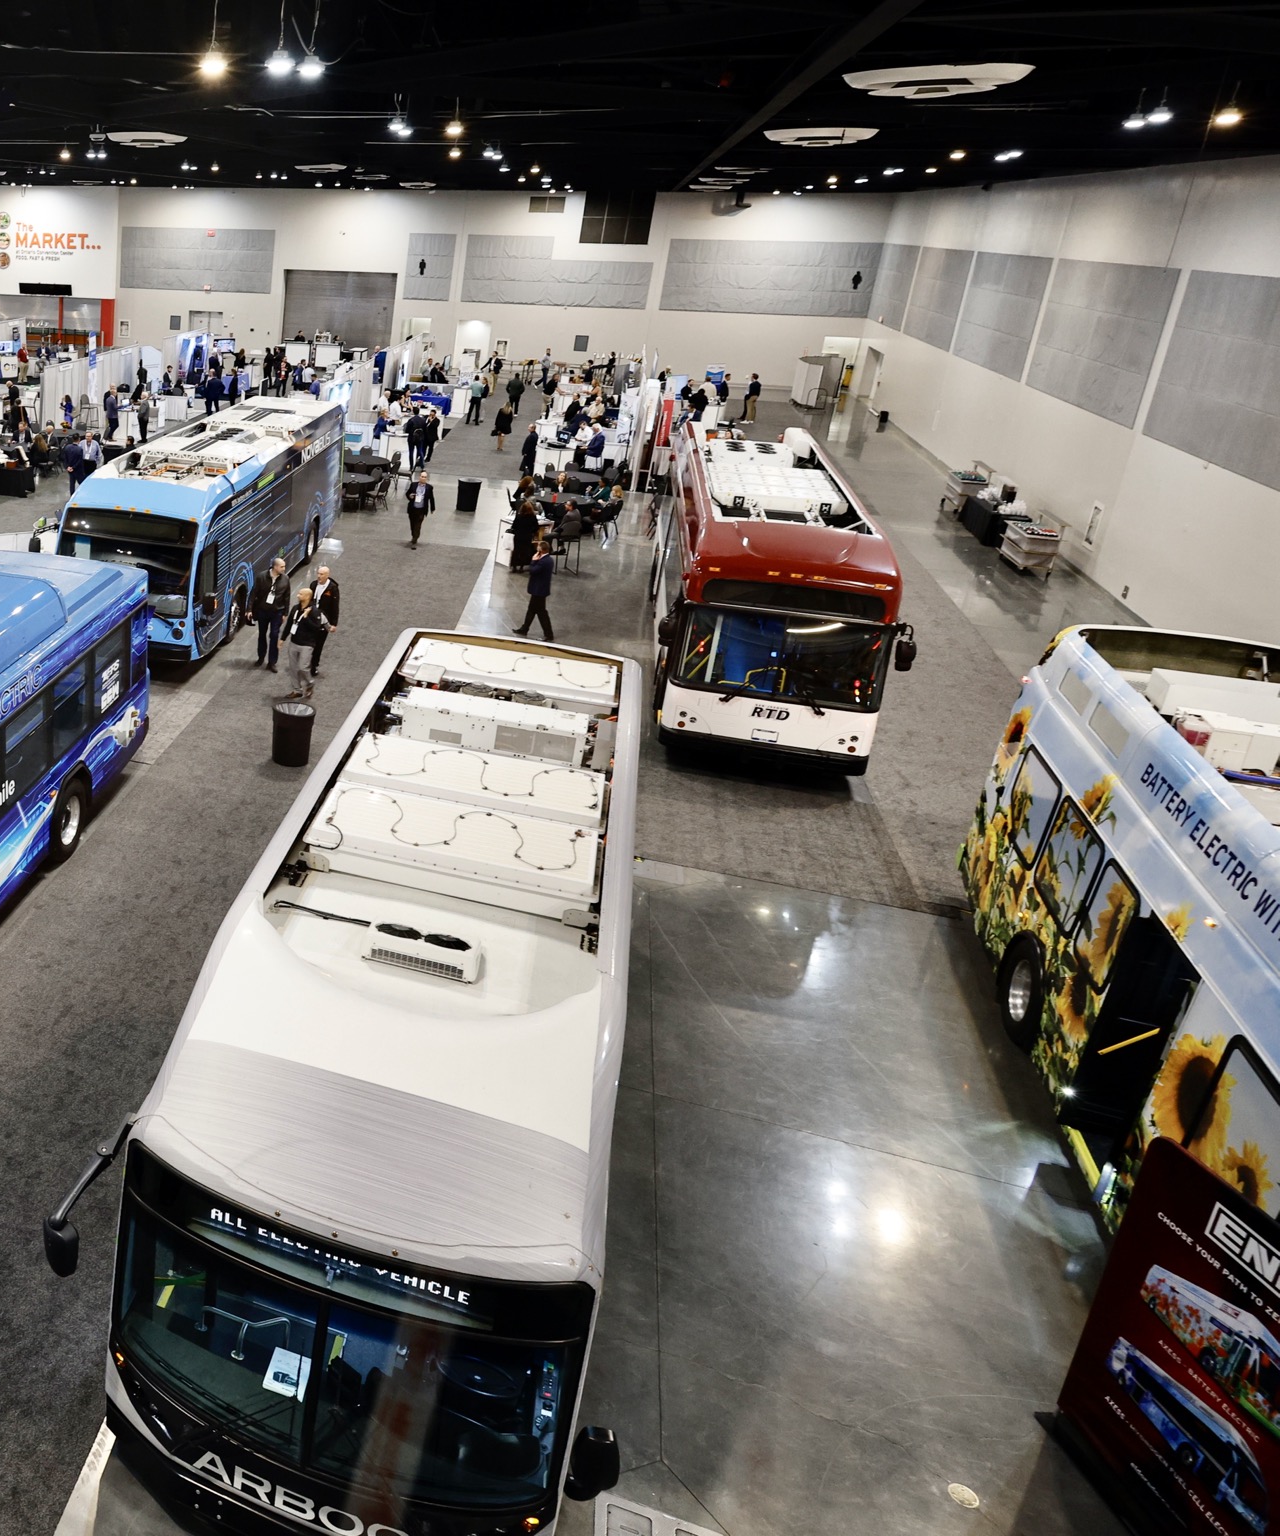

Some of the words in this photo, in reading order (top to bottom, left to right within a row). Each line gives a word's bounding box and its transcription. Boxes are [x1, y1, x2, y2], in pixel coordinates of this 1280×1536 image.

[15, 232, 101, 250] MARKET...
[16, 222, 33, 231] The
[751, 706, 790, 721] RTD
[1140, 762, 1196, 828] BATTERY
[1189, 818, 1258, 900] ELECTRIC
[1253, 889, 1280, 942] WIT
[210, 1208, 247, 1231] ALL
[375, 1268, 470, 1306] VEHICLE
[1156, 1212, 1194, 1246] CHOOSE
[1196, 1244, 1222, 1270] YOUR
[1222, 1268, 1249, 1294] PATH
[1250, 1292, 1264, 1306] TO
[1158, 1339, 1182, 1364] AXESS
[1188, 1368, 1222, 1403] BATTERY
[1221, 1402, 1260, 1443] ELECTRIC
[1104, 1395, 1126, 1420] AXESS
[1169, 1466, 1187, 1490] FUEL
[1187, 1488, 1205, 1513] CELL
